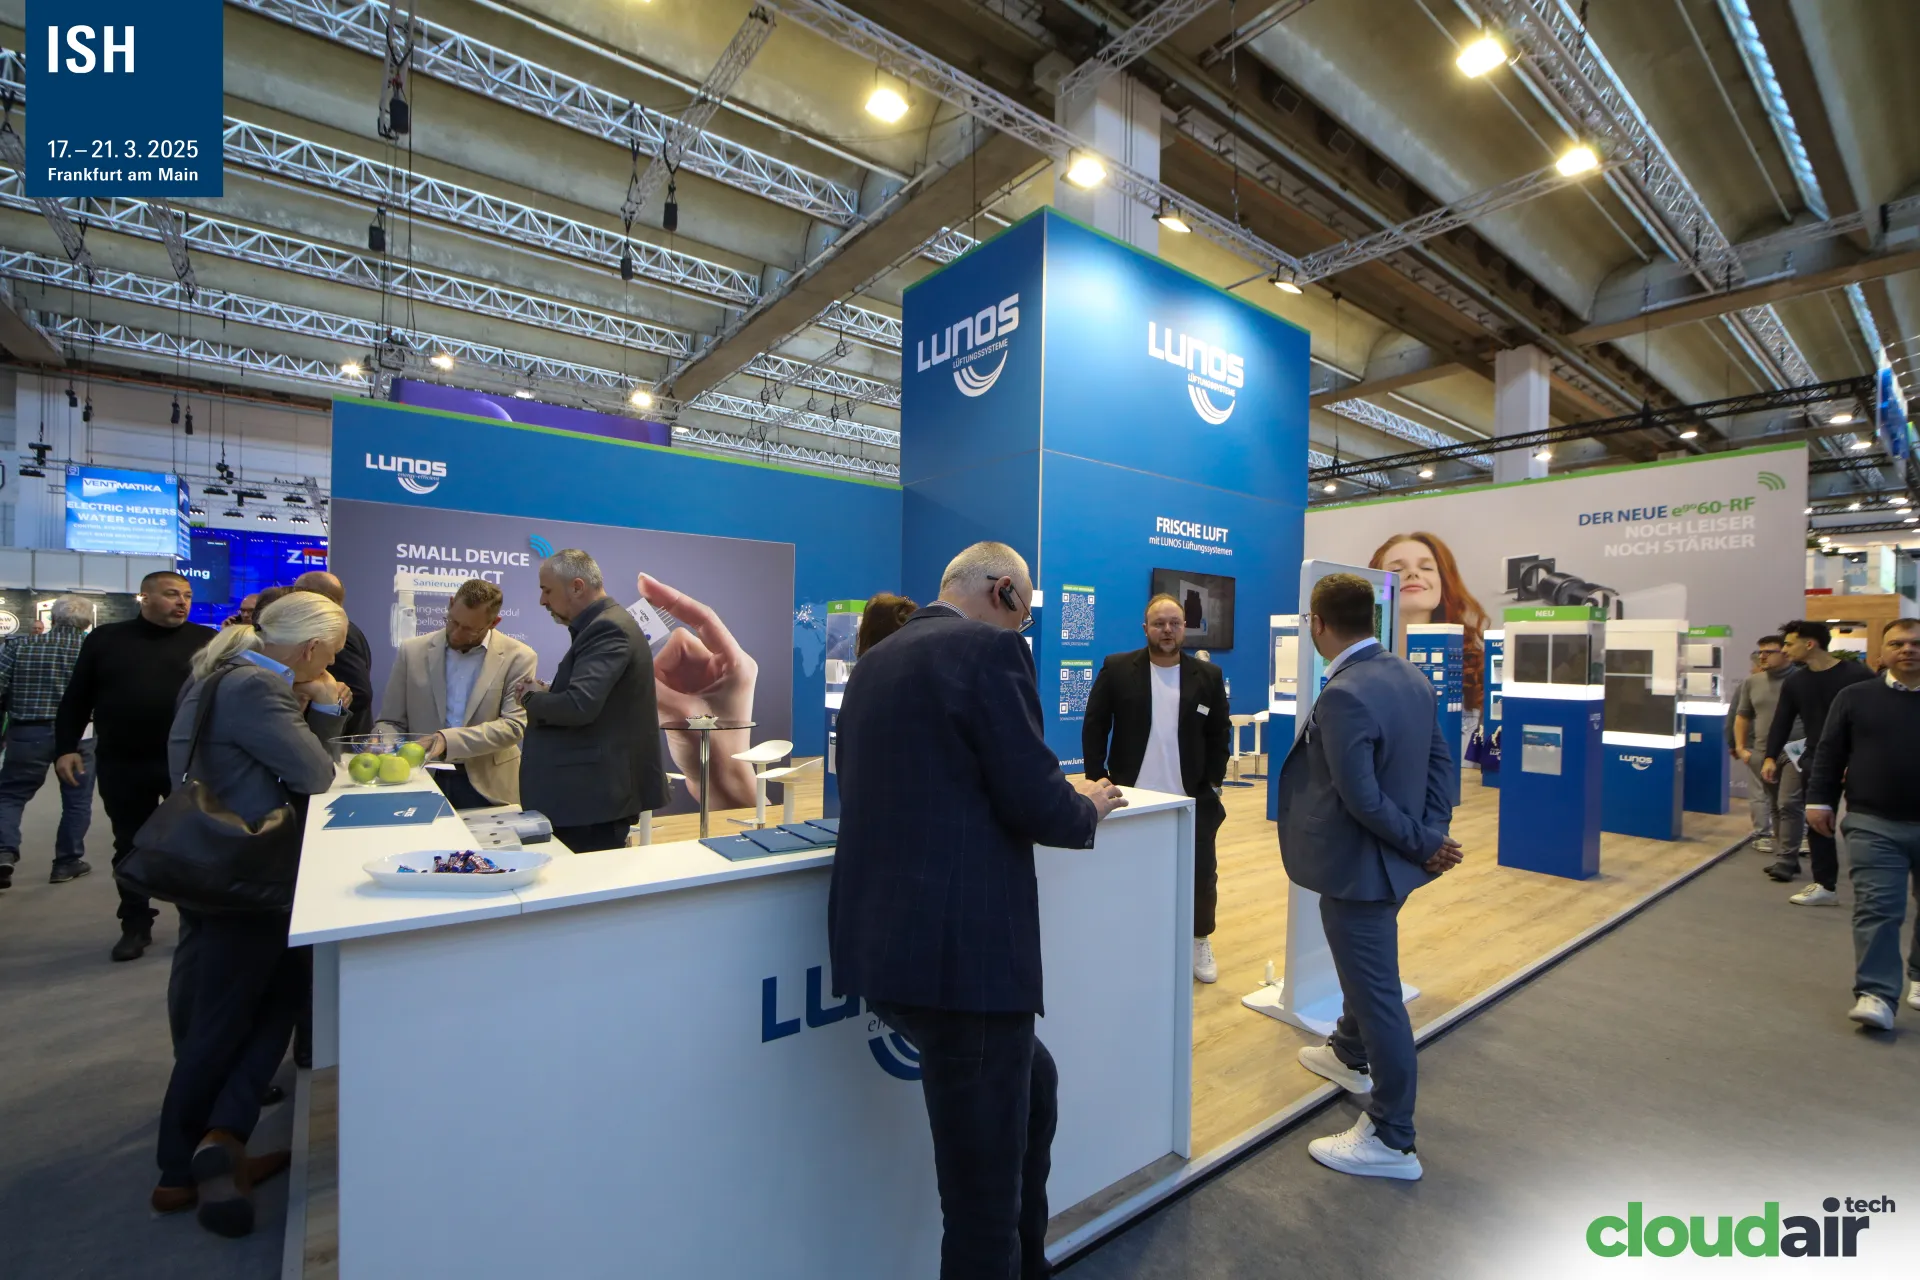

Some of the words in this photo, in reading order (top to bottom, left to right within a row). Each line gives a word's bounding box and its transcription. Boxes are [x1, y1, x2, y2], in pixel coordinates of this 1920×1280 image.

[917, 293, 1019, 372] LUNOS
[952, 338, 1008, 368] LÜFTUNGSSYSTEME
[1148, 321, 1244, 389] LUNOS
[366, 452, 446, 477] LUNOS
[83, 479, 162, 493] VENTMATIKA
[67, 501, 123, 512] ELECTRIC
[126, 505, 176, 516] HEATERS
[78, 513, 124, 523] WATER
[128, 517, 168, 526] COILS
[1579, 511, 1613, 526] DER
[1617, 505, 1668, 523] NEUE
[1156, 516, 1201, 539] FRISCHE
[1203, 525, 1228, 543] LUFT
[1625, 522, 1681, 539] NOCH
[1687, 515, 1756, 534] LEISER
[286, 549, 328, 565] ZIE
[396, 543, 462, 562] SMALL
[466, 549, 530, 567] DEVICE
[1149, 536, 1159, 546] mit
[1161, 537, 1181, 549] LUNOS
[1182, 540, 1233, 556] Lüftungssystemen
[1604, 541, 1659, 558] NOCH
[1664, 534, 1756, 554] STÄRKER
[176, 567, 210, 580] aving
[1619, 754, 1653, 765] LUNOS
